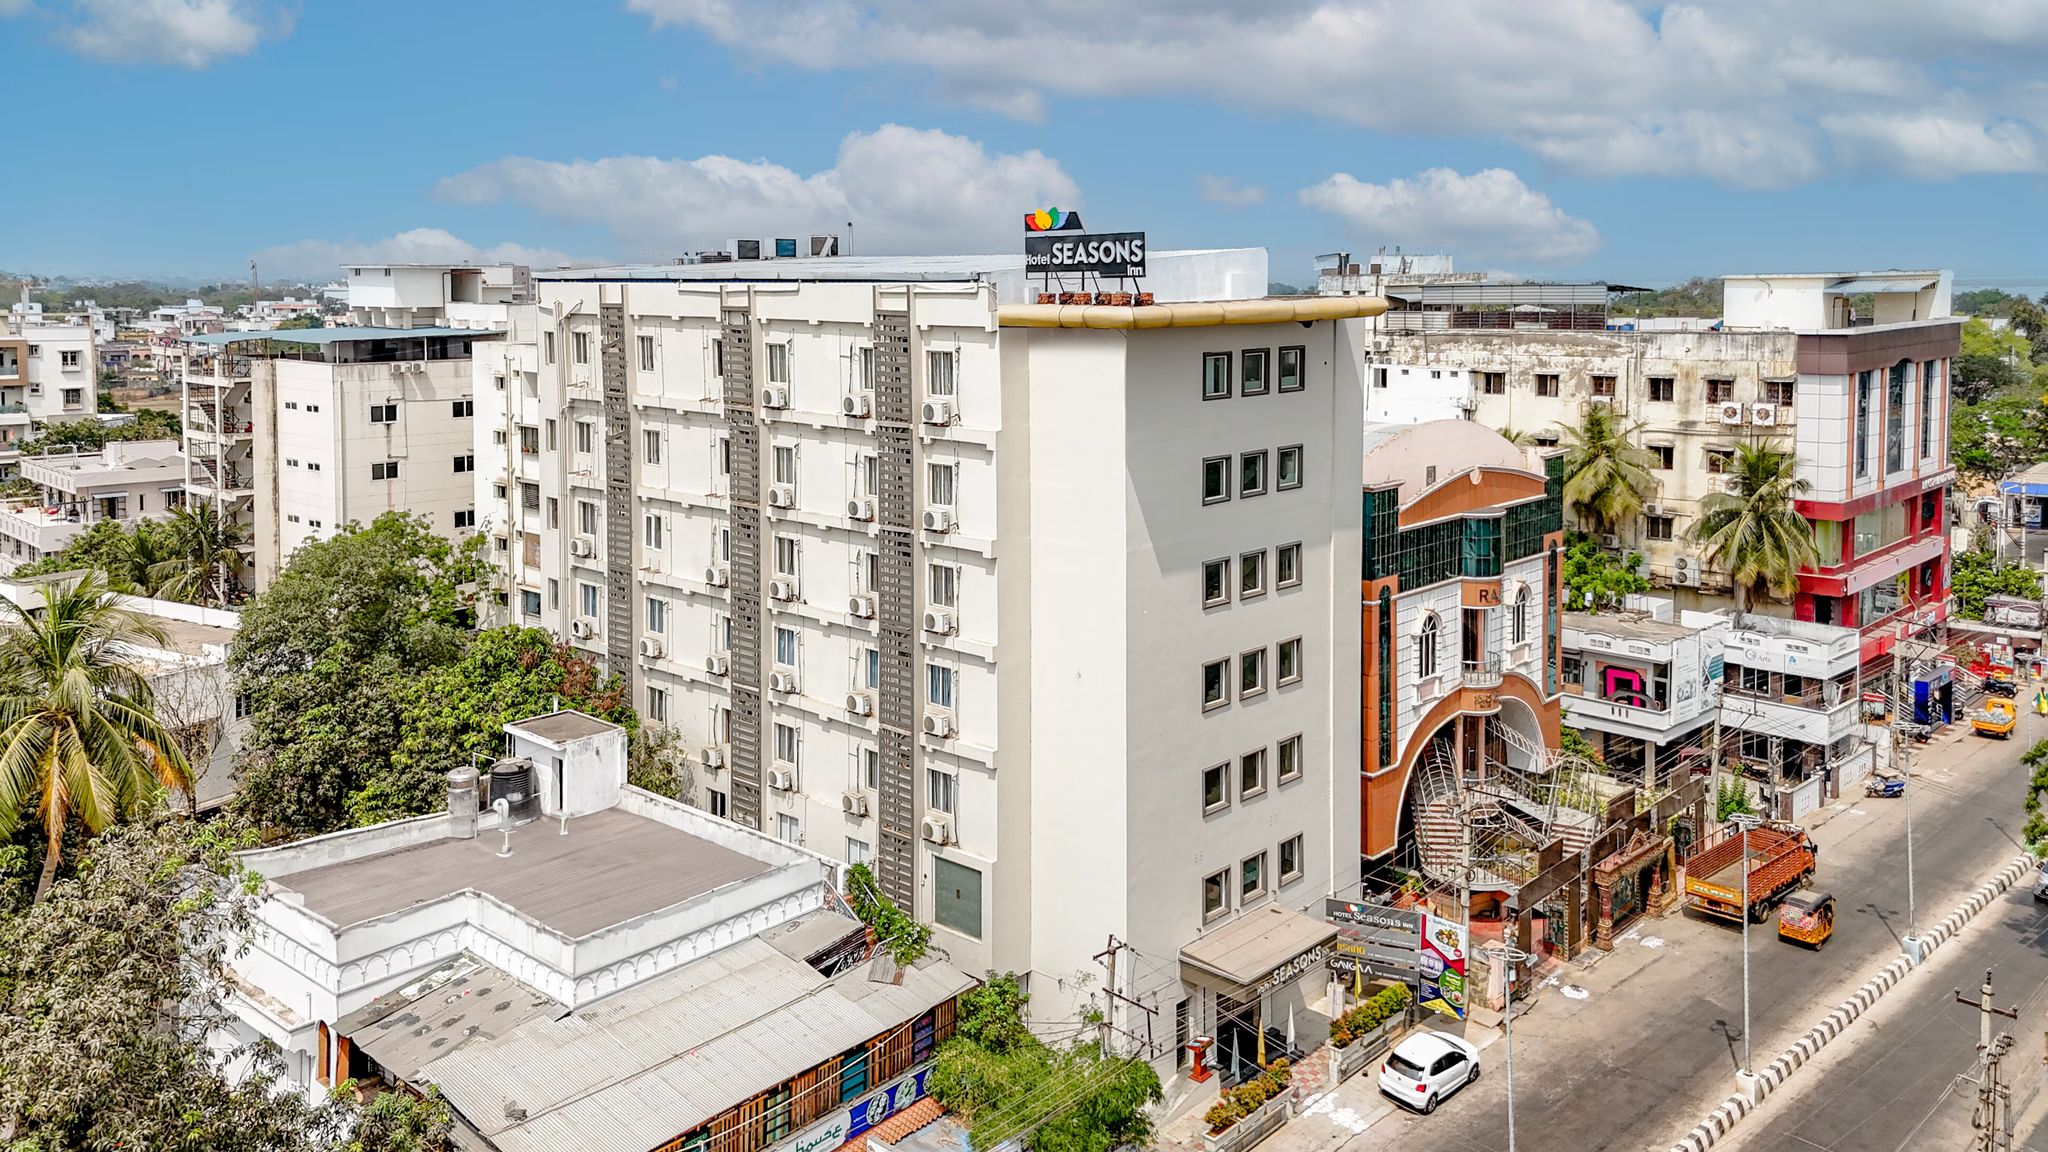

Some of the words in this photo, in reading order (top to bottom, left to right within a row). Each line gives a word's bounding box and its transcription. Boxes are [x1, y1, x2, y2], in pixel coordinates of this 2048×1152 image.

[1026, 254, 1051, 266] Hotel
[1051, 239, 1144, 265] SEASONS
[1127, 264, 1143, 277] Inn
[1333, 911, 1353, 919] HOTEL
[1353, 911, 1401, 927] Seasons
[1272, 945, 1322, 985] SEASONS
